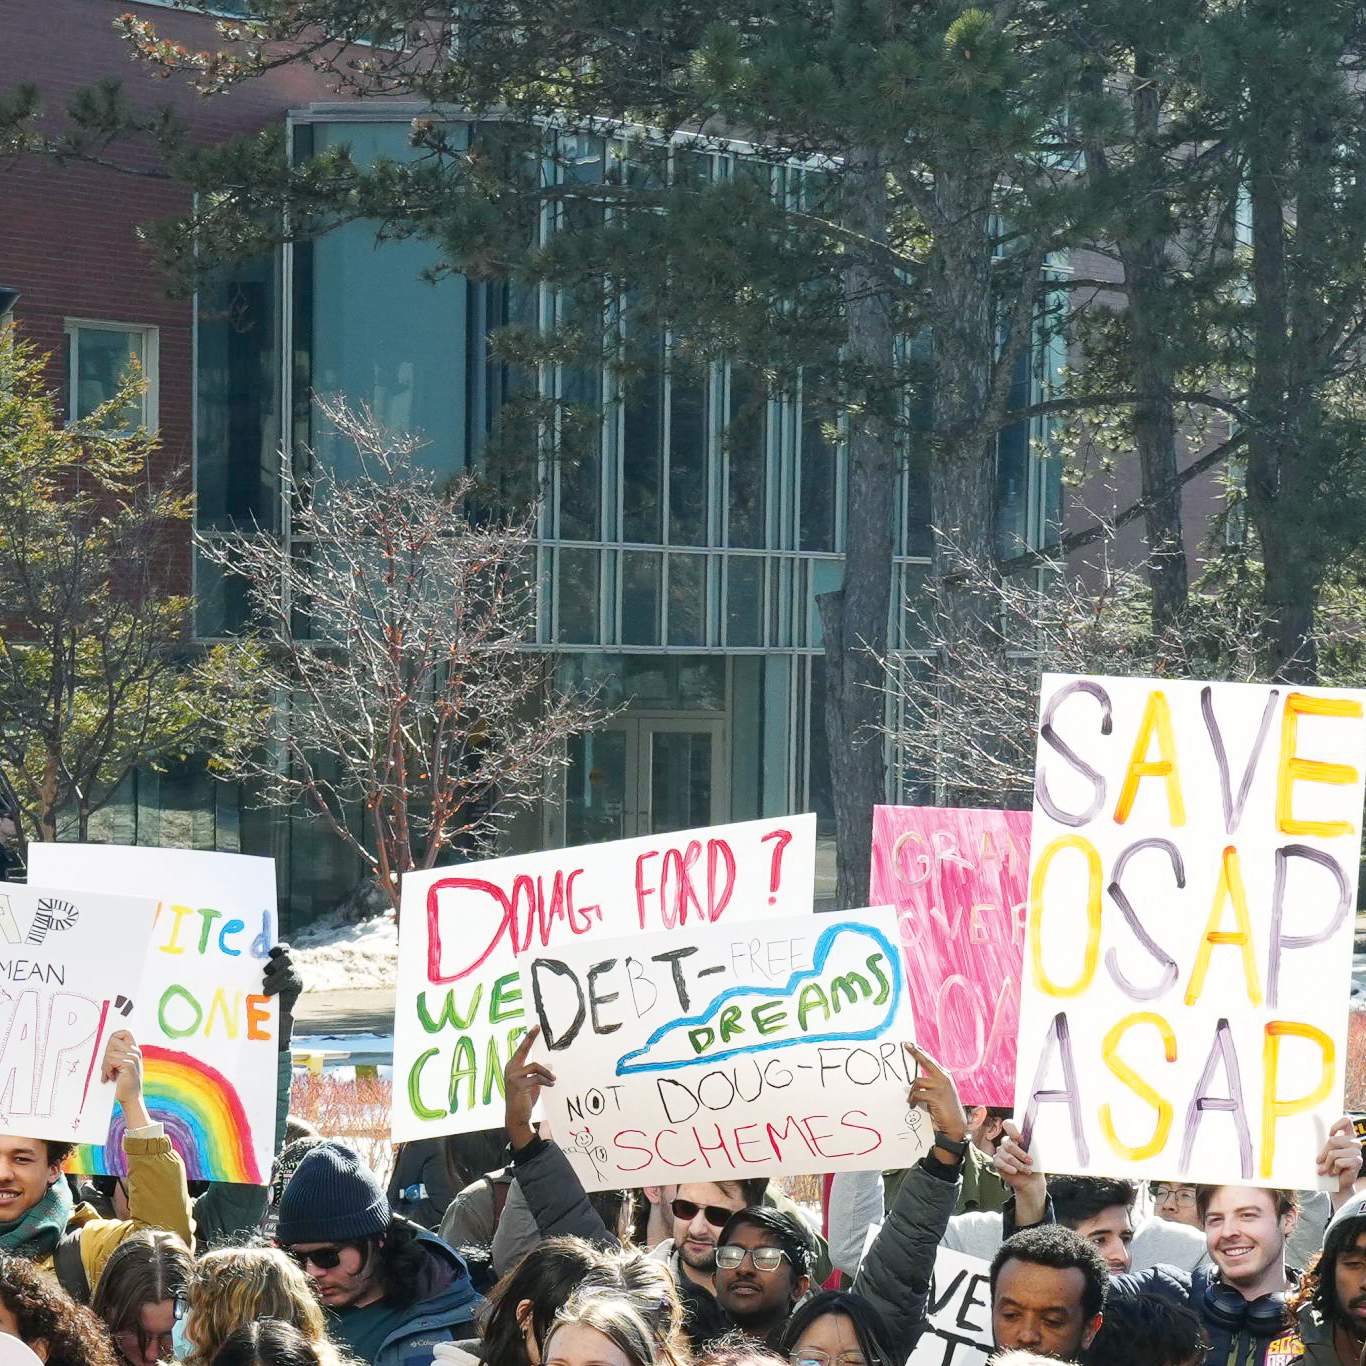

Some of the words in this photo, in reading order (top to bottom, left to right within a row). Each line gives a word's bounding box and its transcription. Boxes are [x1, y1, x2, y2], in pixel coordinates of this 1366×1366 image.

[1035, 679, 1363, 838] SAVE
[152, 902, 272, 960] ITed
[427, 868, 603, 985] DOUG
[635, 838, 736, 930] FORD
[1030, 834, 1353, 1009] OSAP
[157, 983, 272, 1041] ONE
[417, 971, 527, 1034] WE
[688, 952, 892, 1054] DREAMS
[566, 1084, 626, 1123] NOT
[1021, 1011, 1337, 1180] ASAP
[613, 1110, 883, 1171] SCHEMES
